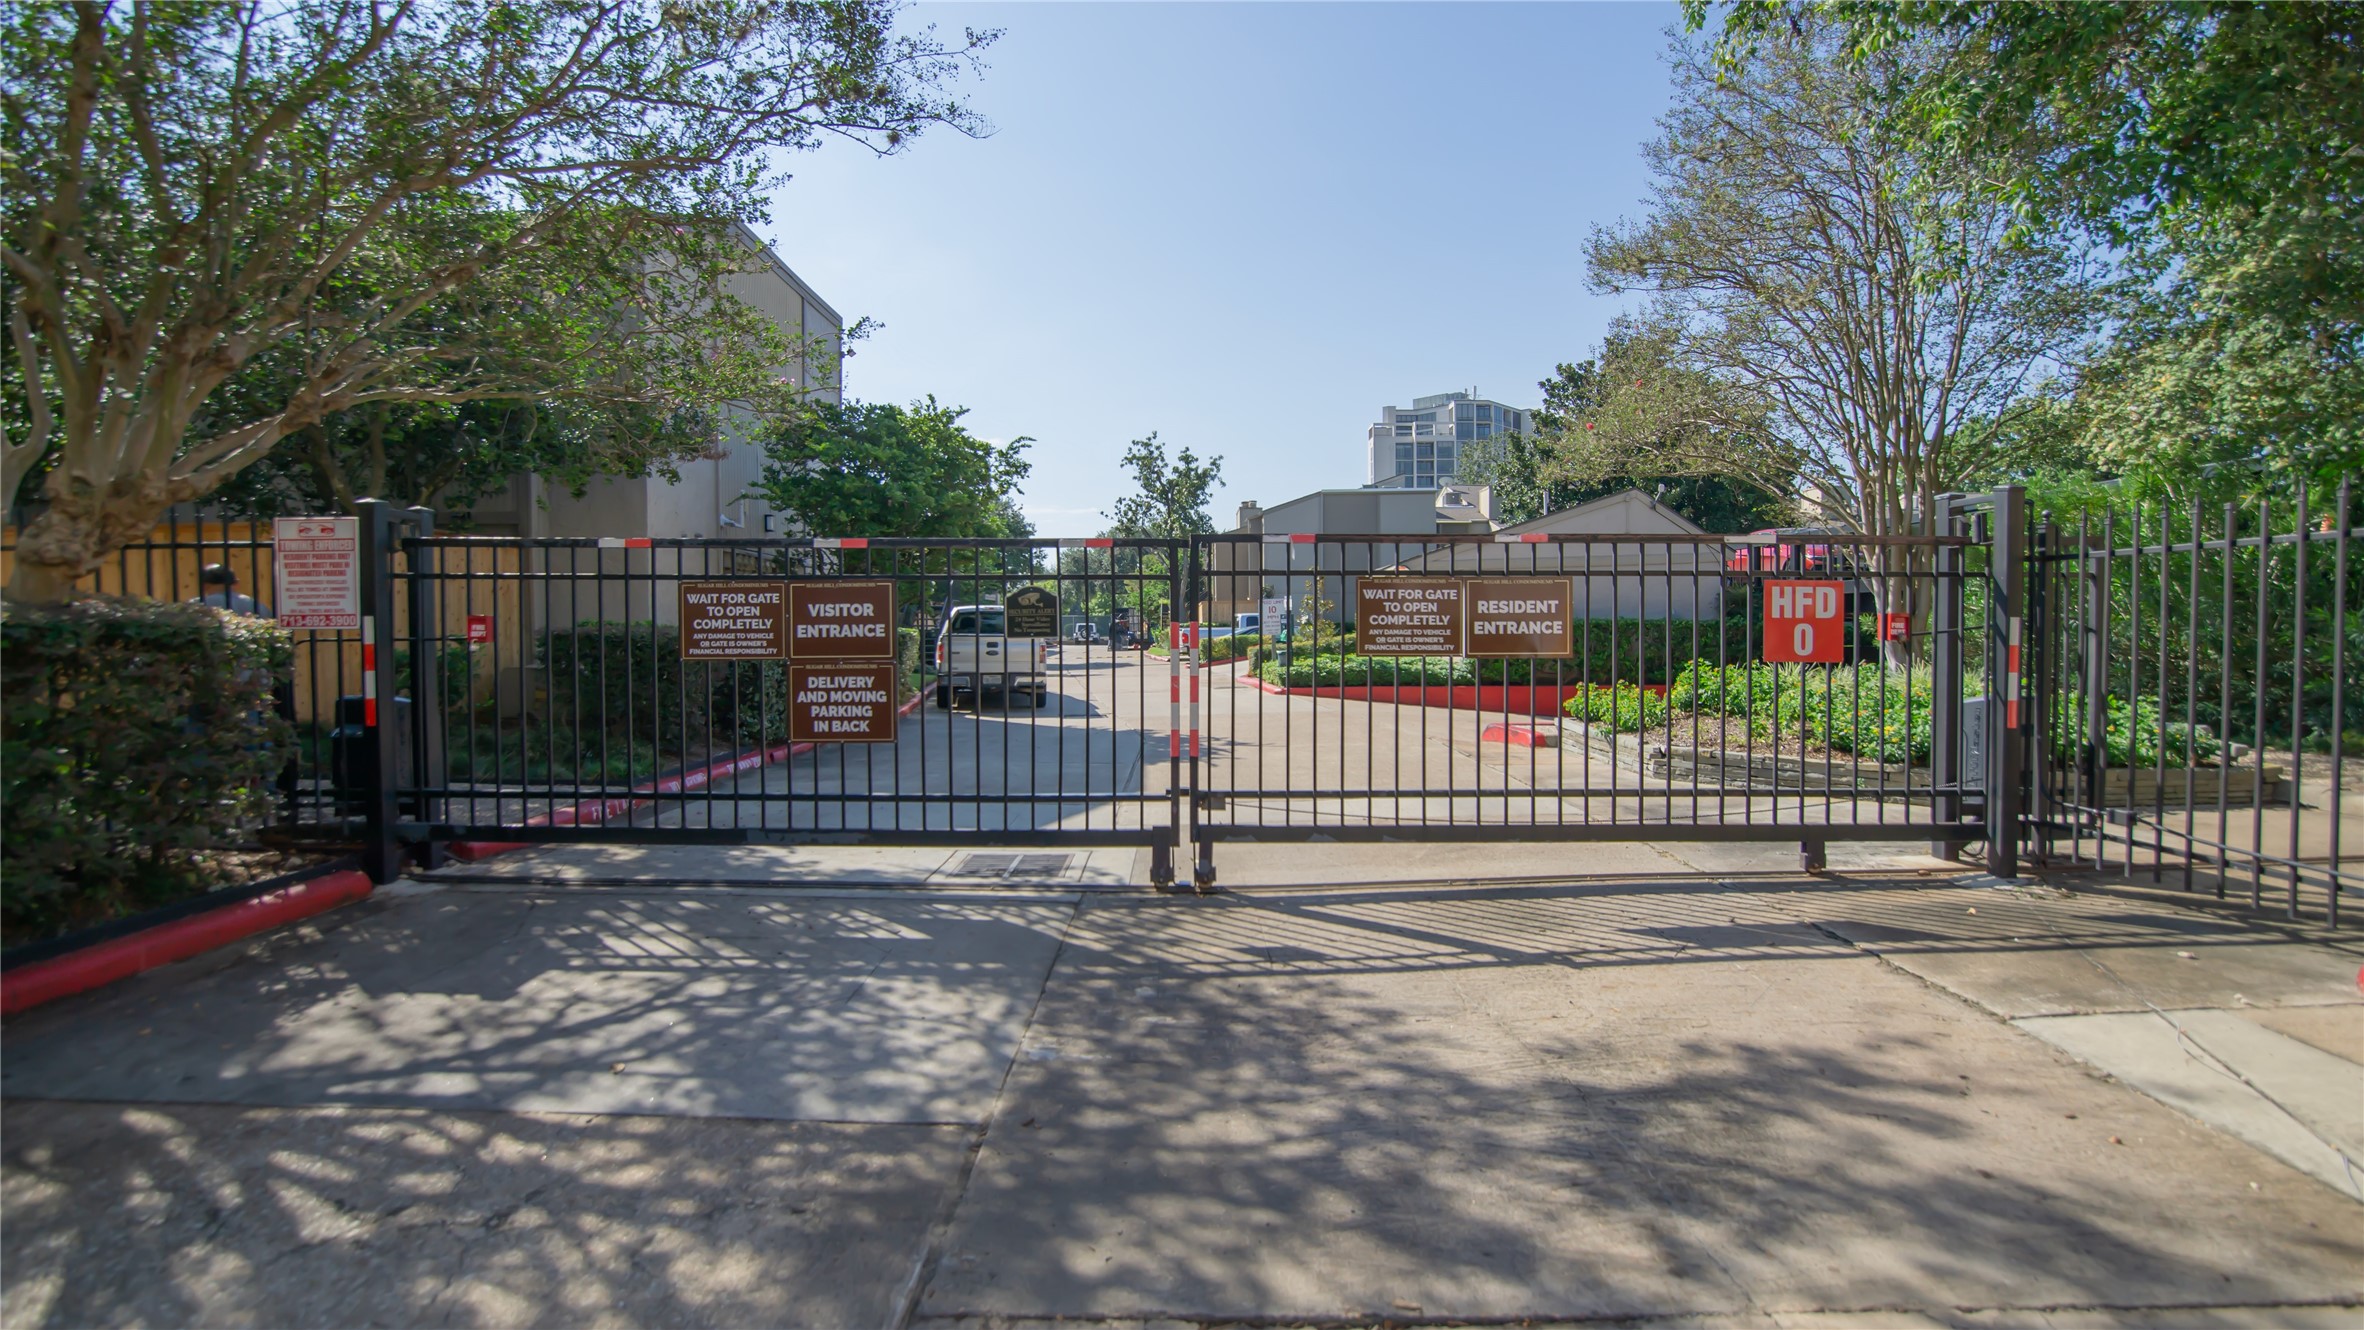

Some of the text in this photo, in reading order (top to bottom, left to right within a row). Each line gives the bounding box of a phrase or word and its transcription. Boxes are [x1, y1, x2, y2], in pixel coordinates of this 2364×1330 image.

[687, 593, 780, 604] WAIT FOR GATE
[1363, 589, 1458, 600] WAIT FOR GATE
[1383, 602, 1438, 612] TO OPEN
[1477, 600, 1559, 614] RESIDENT
[1771, 586, 1836, 619] HFD
[706, 606, 760, 617] TO OPEN
[808, 603, 875, 617] VISITOR
[1268, 605, 1277, 614] 10
[281, 615, 357, 627] 713-692-3900
[693, 619, 773, 629] COMPLETELY
[1369, 615, 1451, 625] COMPLETELY
[797, 624, 886, 638] ENTRANCE
[1474, 621, 1563, 635] ENTRANCE
[807, 676, 875, 688] DELIVERY
[796, 691, 887, 703] AND MOVING
[811, 705, 873, 717] PARKING
[814, 720, 870, 732] IN BACK
